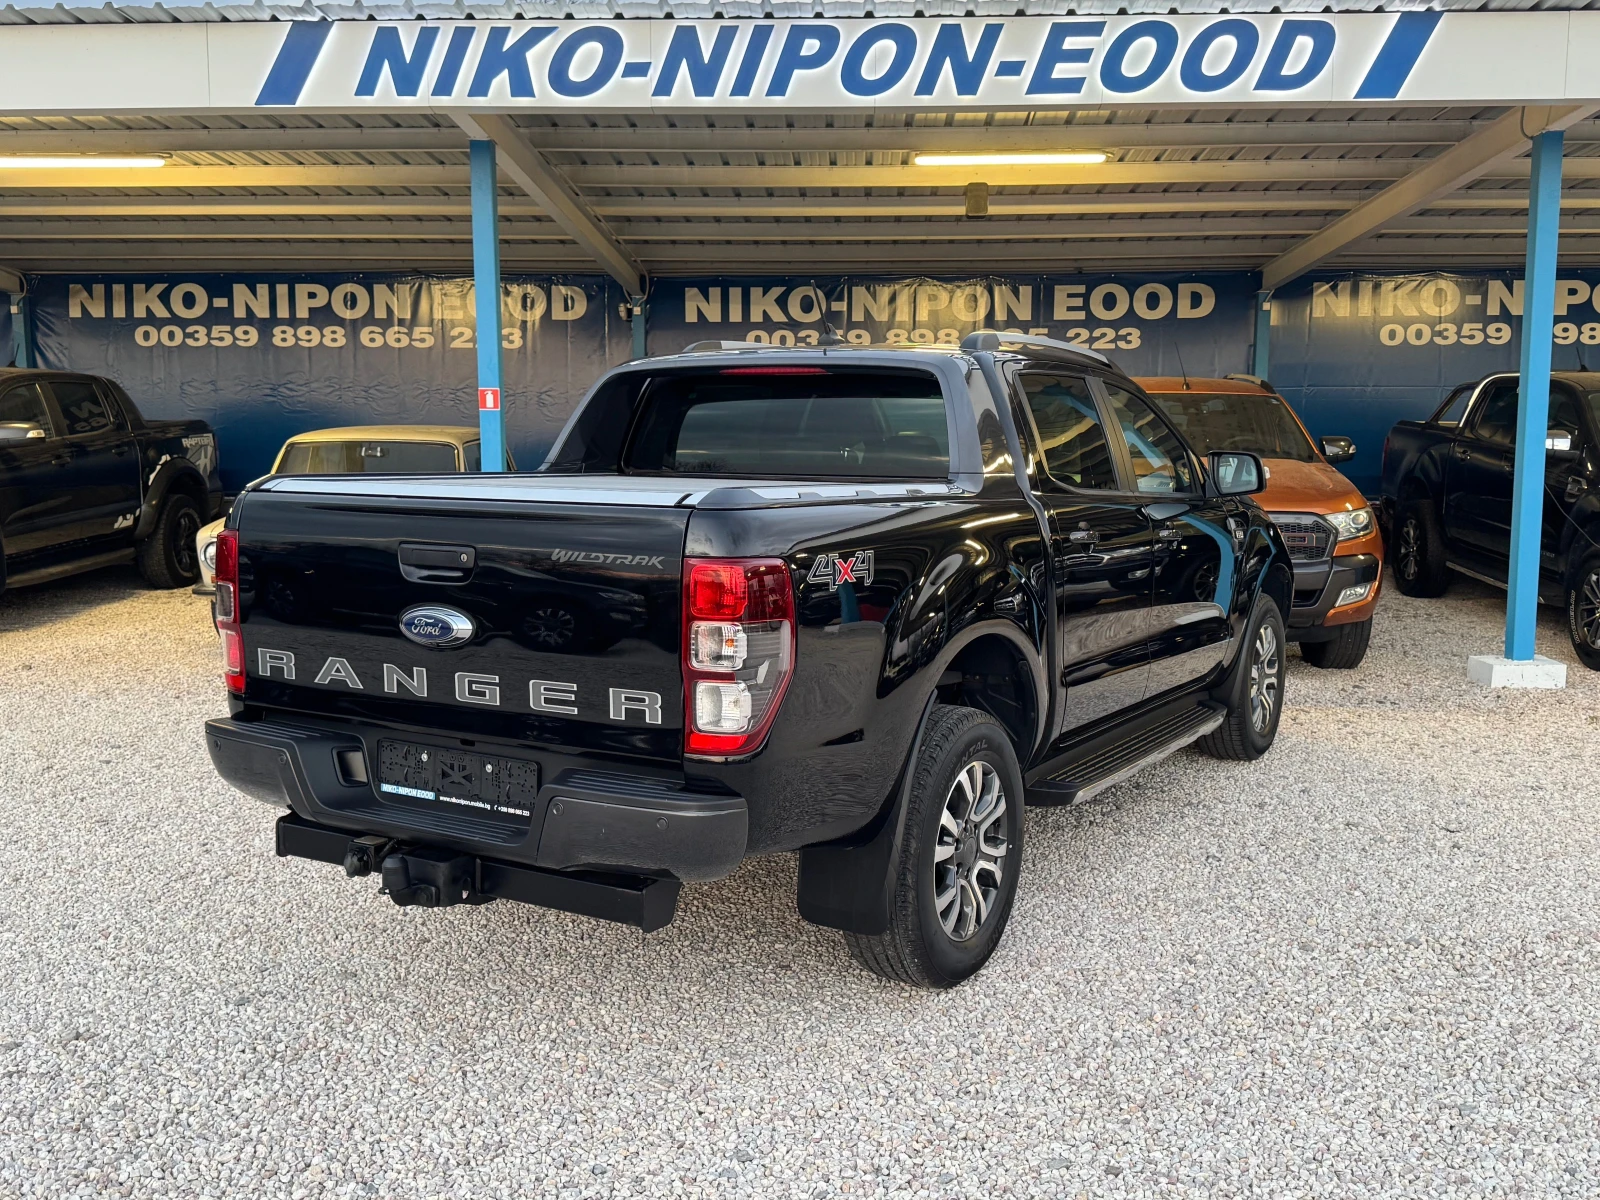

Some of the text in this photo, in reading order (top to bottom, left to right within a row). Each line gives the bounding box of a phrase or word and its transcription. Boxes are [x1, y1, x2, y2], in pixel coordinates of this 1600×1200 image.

[354, 18, 1336, 98] NIKO-NIPON-EOOD
[69, 283, 588, 321] NIKO-NIPON EOD
[685, 283, 1216, 322] NIKO-NIPON EOOD
[1312, 279, 1600, 317] NIKO-NP
[134, 325, 523, 349] 00359 898 665 23
[745, 329, 871, 347] 0039
[885, 328, 961, 347] 898
[1065, 327, 1141, 350] 223
[1379, 322, 1600, 346] 00359 98
[181, 436, 211, 449] RAPTOR
[550, 548, 665, 569] WILDTRAK
[410, 616, 442, 637] Ford
[257, 647, 662, 725] RANGER
[382, 783, 417, 798] NIKO-NIPON
